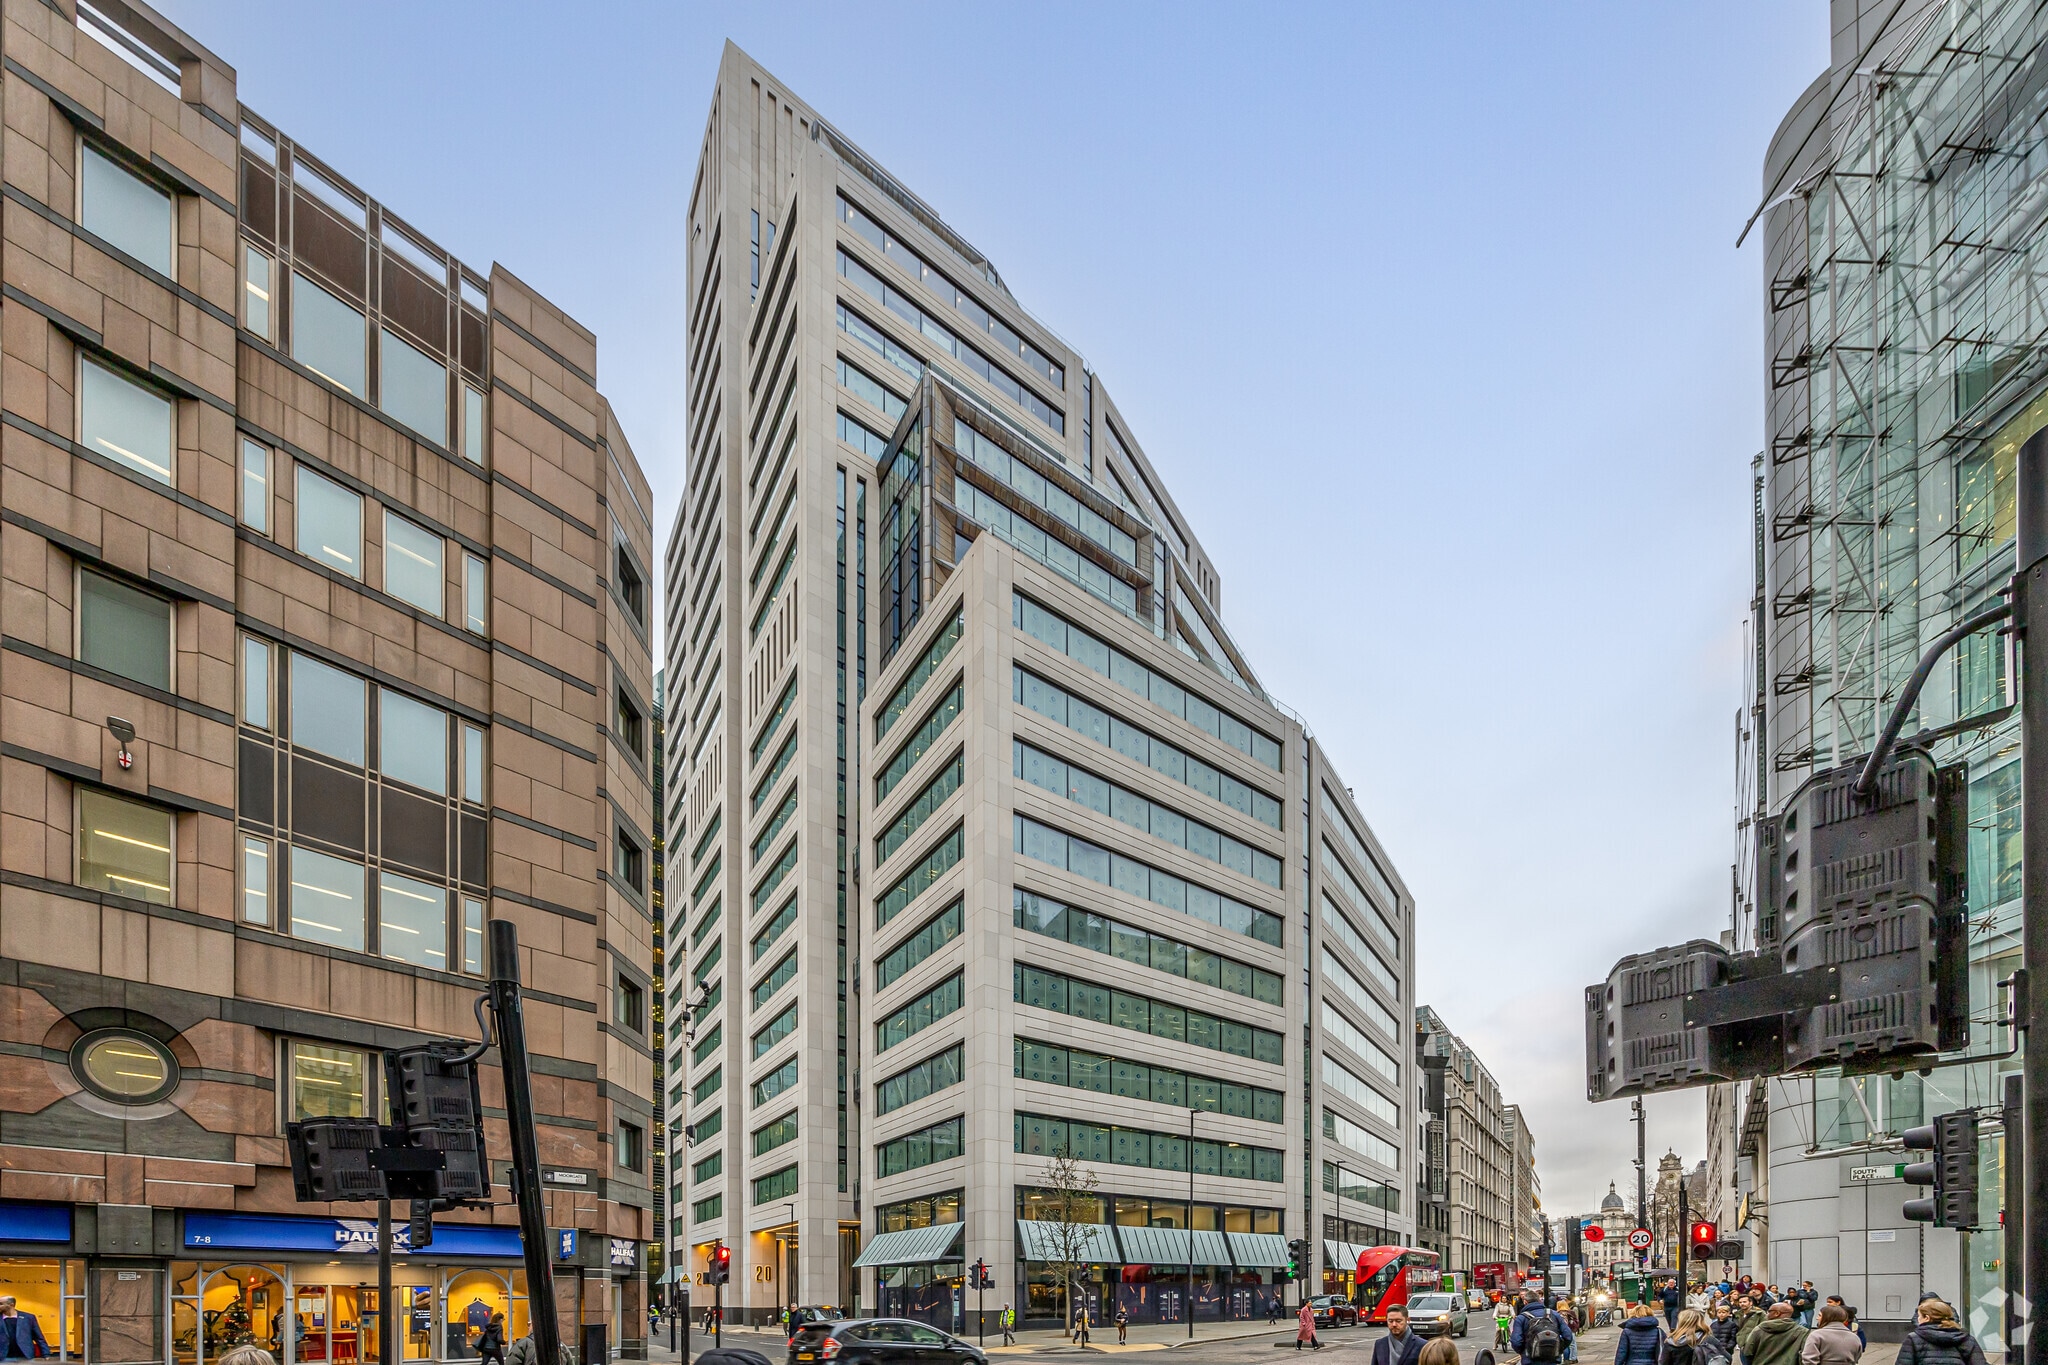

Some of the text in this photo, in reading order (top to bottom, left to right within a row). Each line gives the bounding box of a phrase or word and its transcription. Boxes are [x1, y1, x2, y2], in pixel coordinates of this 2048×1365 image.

[194, 1235, 211, 1244] 7-8
[335, 1230, 411, 1244] HALIX
[1632, 1234, 1650, 1244] 20
[611, 1247, 635, 1258] HALIFAX
[756, 1265, 772, 1282] 20
